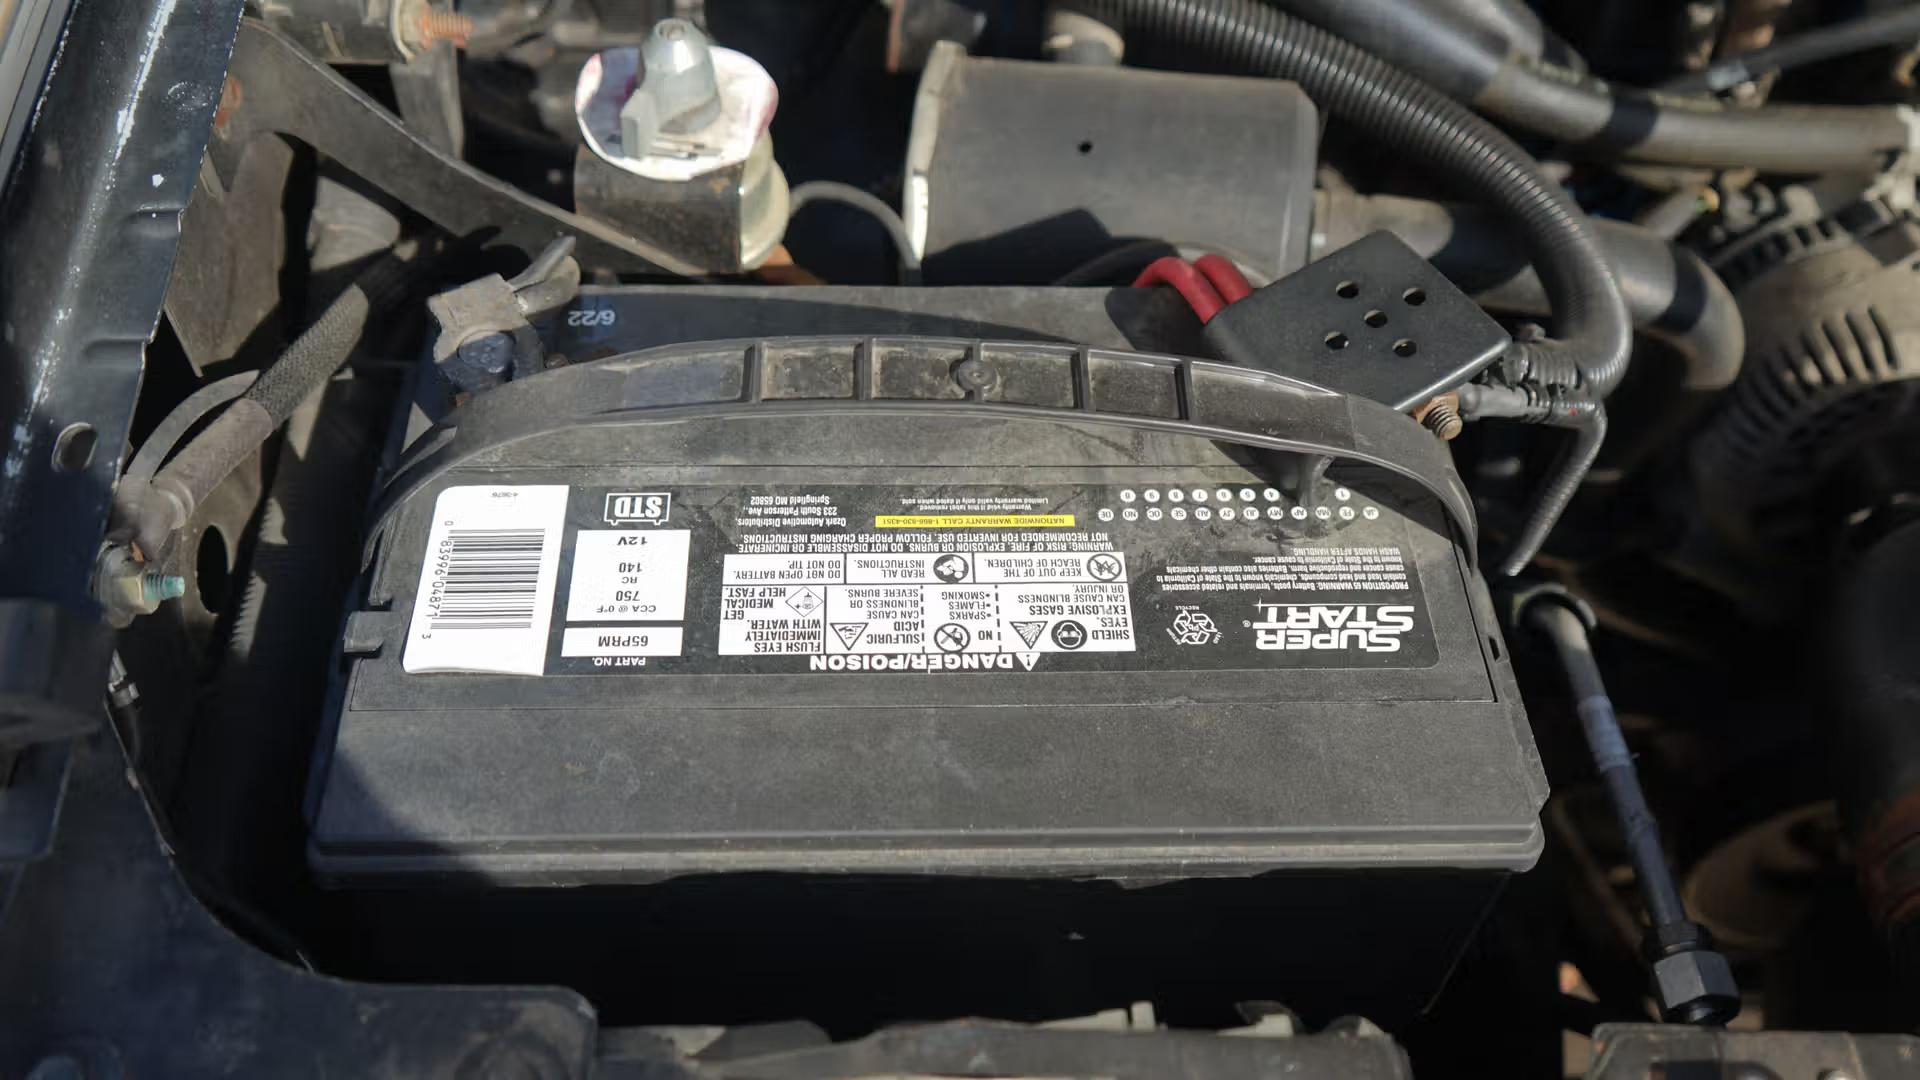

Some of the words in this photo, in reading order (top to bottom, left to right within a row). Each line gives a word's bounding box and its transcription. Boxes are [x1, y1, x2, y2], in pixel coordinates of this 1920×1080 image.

[568, 310, 616, 326] 6/22
[750, 496, 774, 504] 65802
[776, 496, 788, 504] MO
[789, 496, 830, 505] Springfield
[614, 496, 662, 518] STD
[764, 506, 798, 516] Patterson
[800, 506, 822, 516] South
[822, 506, 838, 516] 233
[782, 518, 824, 526] Automotive
[826, 518, 846, 526] Ozark
[617, 536, 648, 546] 12V
[740, 534, 808, 543] INSTRUCTIONS.
[810, 534, 856, 542] CHARGING
[858, 534, 893, 542] PROPER
[896, 534, 932, 542] FOLLOW
[934, 533, 954, 542] USE.
[956, 533, 998, 542] INVERTED
[1001, 533, 1018, 542] FOR
[1021, 532, 1088, 542] RECOMMENDED
[1090, 532, 1108, 541] NOT
[735, 544, 790, 552] INCINERATE.
[792, 544, 804, 552] OR
[807, 543, 868, 552] DISASSEMBLE
[870, 543, 888, 552] NOT
[891, 543, 904, 552] DO
[906, 542, 939, 552] BURNS.
[942, 542, 954, 551] OR
[956, 542, 1005, 551] EXPLOSION
[1007, 541, 1030, 551] FIRE,
[1032, 542, 1044, 550] OF
[1046, 542, 1066, 550] RISK
[1068, 542, 1114, 550] WARNING:
[1330, 547, 1352, 555] AFTER
[1379, 547, 1400, 555] WASH
[434, 540, 452, 576] 83996
[984, 558, 1034, 567] CHILDREN.
[1036, 558, 1048, 567] OF
[1050, 558, 1080, 567] REACH
[618, 562, 642, 573] 140
[788, 560, 803, 568] TIP.
[807, 560, 824, 568] NOT
[828, 560, 840, 568] DO
[854, 560, 924, 568] INSTRUCTIONS.
[733, 570, 776, 579] BATTERY.
[778, 570, 803, 578] OPEN
[807, 570, 824, 578] NOT
[828, 570, 840, 578] DO
[881, 570, 898, 578] ALL
[900, 569, 924, 578] READ
[1004, 568, 1021, 577] THE
[1023, 568, 1035, 576] OF
[1038, 568, 1056, 576] OUT
[1060, 568, 1082, 576] KEEP
[1072, 584, 1108, 593] INJURY.
[1110, 584, 1124, 593] OR
[1162, 584, 1200, 592] accessories
[1202, 583, 1224, 592] related
[1226, 583, 1238, 591] and
[1239, 582, 1270, 591] terminals
[1292, 580, 1315, 591] Battery
[1316, 582, 1353, 590] WARNING:
[1362, 582, 1408, 590] PROPOSITION
[615, 590, 640, 602] 750
[726, 587, 756, 597] FAST.
[759, 587, 786, 597] HELP
[844, 588, 880, 597] BURNS.
[884, 588, 918, 597] SEVERE
[941, 591, 985, 600] SMOKING
[426, 582, 444, 618] 04871
[1018, 594, 1070, 602] BLINDNESS
[1074, 594, 1104, 602] CAUSE
[1106, 594, 1124, 602] CAN
[724, 598, 774, 608] MEDICAL
[850, 600, 863, 608] OR
[866, 600, 918, 608] BLINDNESS
[948, 601, 986, 610] FLAMES
[618, 604, 628, 613] @
[632, 604, 656, 613] CCA
[1029, 605, 1064, 615] GASES
[1068, 604, 1126, 615] EXPLOSIVE
[723, 610, 744, 620] GET
[866, 610, 897, 618] CAUSE
[900, 610, 919, 618] CAN
[948, 611, 986, 620] SPARKS
[1252, 605, 1415, 631] START
[746, 619, 789, 630] WATER.
[793, 619, 820, 630] WITH
[894, 621, 919, 631] ACID
[1096, 617, 1128, 627] EYES.
[745, 631, 820, 641] IMMEDIATELY
[866, 634, 920, 644] SULFURIC
[978, 630, 992, 640] NO
[1092, 630, 1130, 640] SHIELD
[598, 636, 648, 647] 65PRM
[1255, 629, 1401, 652] SUPER
[754, 642, 782, 652] EYES
[786, 642, 820, 652] FLUSH
[592, 657, 612, 666] NO.
[614, 657, 646, 666] PART
[810, 654, 1013, 670] DANGER/POISON
